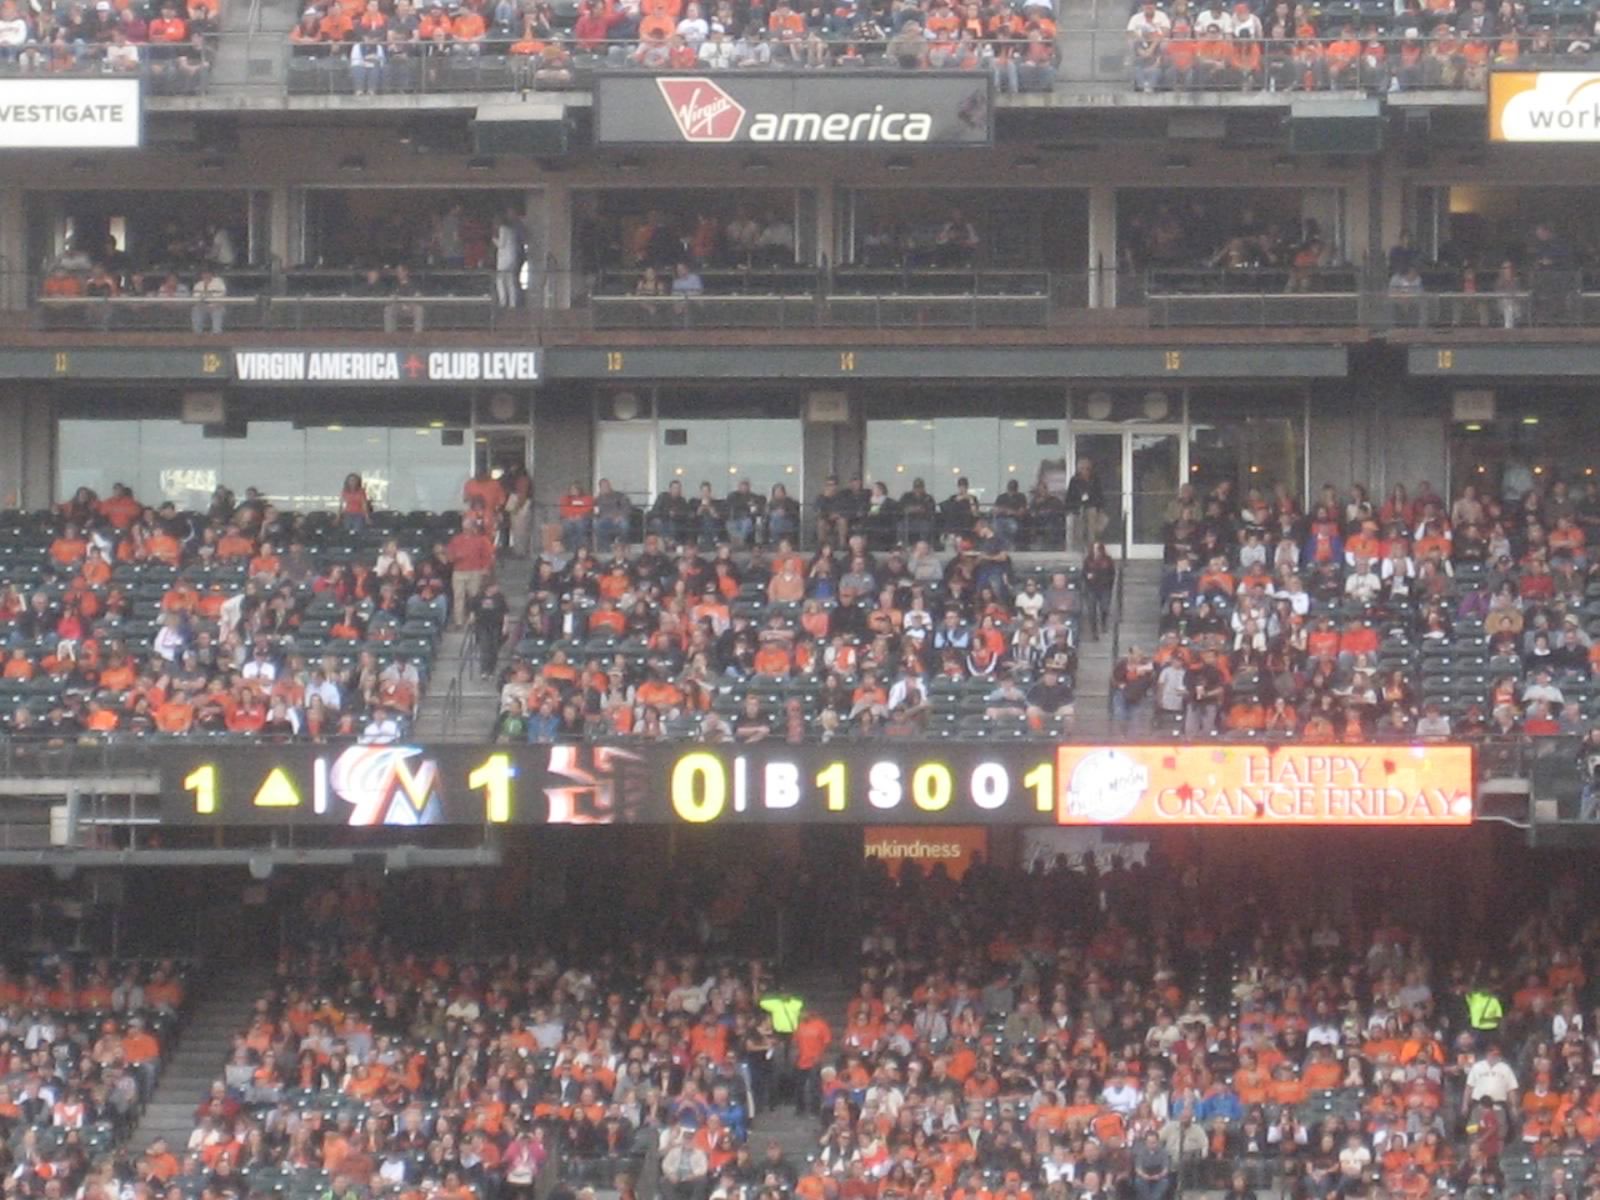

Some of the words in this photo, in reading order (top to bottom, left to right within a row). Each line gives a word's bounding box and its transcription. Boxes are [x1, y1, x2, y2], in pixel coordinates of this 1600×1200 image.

[0, 104, 124, 122] VESTIGATE
[679, 88, 731, 135] Virgin
[750, 104, 932, 141] america
[235, 352, 304, 380] VIRGIN
[307, 352, 399, 380] AMERICA
[428, 352, 480, 380] CLUB
[483, 352, 538, 380] LEVEL
[1244, 755, 1370, 787] HAPPY
[184, 765, 216, 815] 1
[468, 754, 512, 823] 1
[671, 753, 727, 824] 0
[765, 762, 799, 808] B
[816, 763, 846, 811] 1
[868, 761, 902, 808] S
[912, 763, 952, 811] 0
[1024, 763, 1054, 811] 1
[1154, 786, 1317, 819] ORANGE
[1324, 786, 1458, 819] FRIDAY
